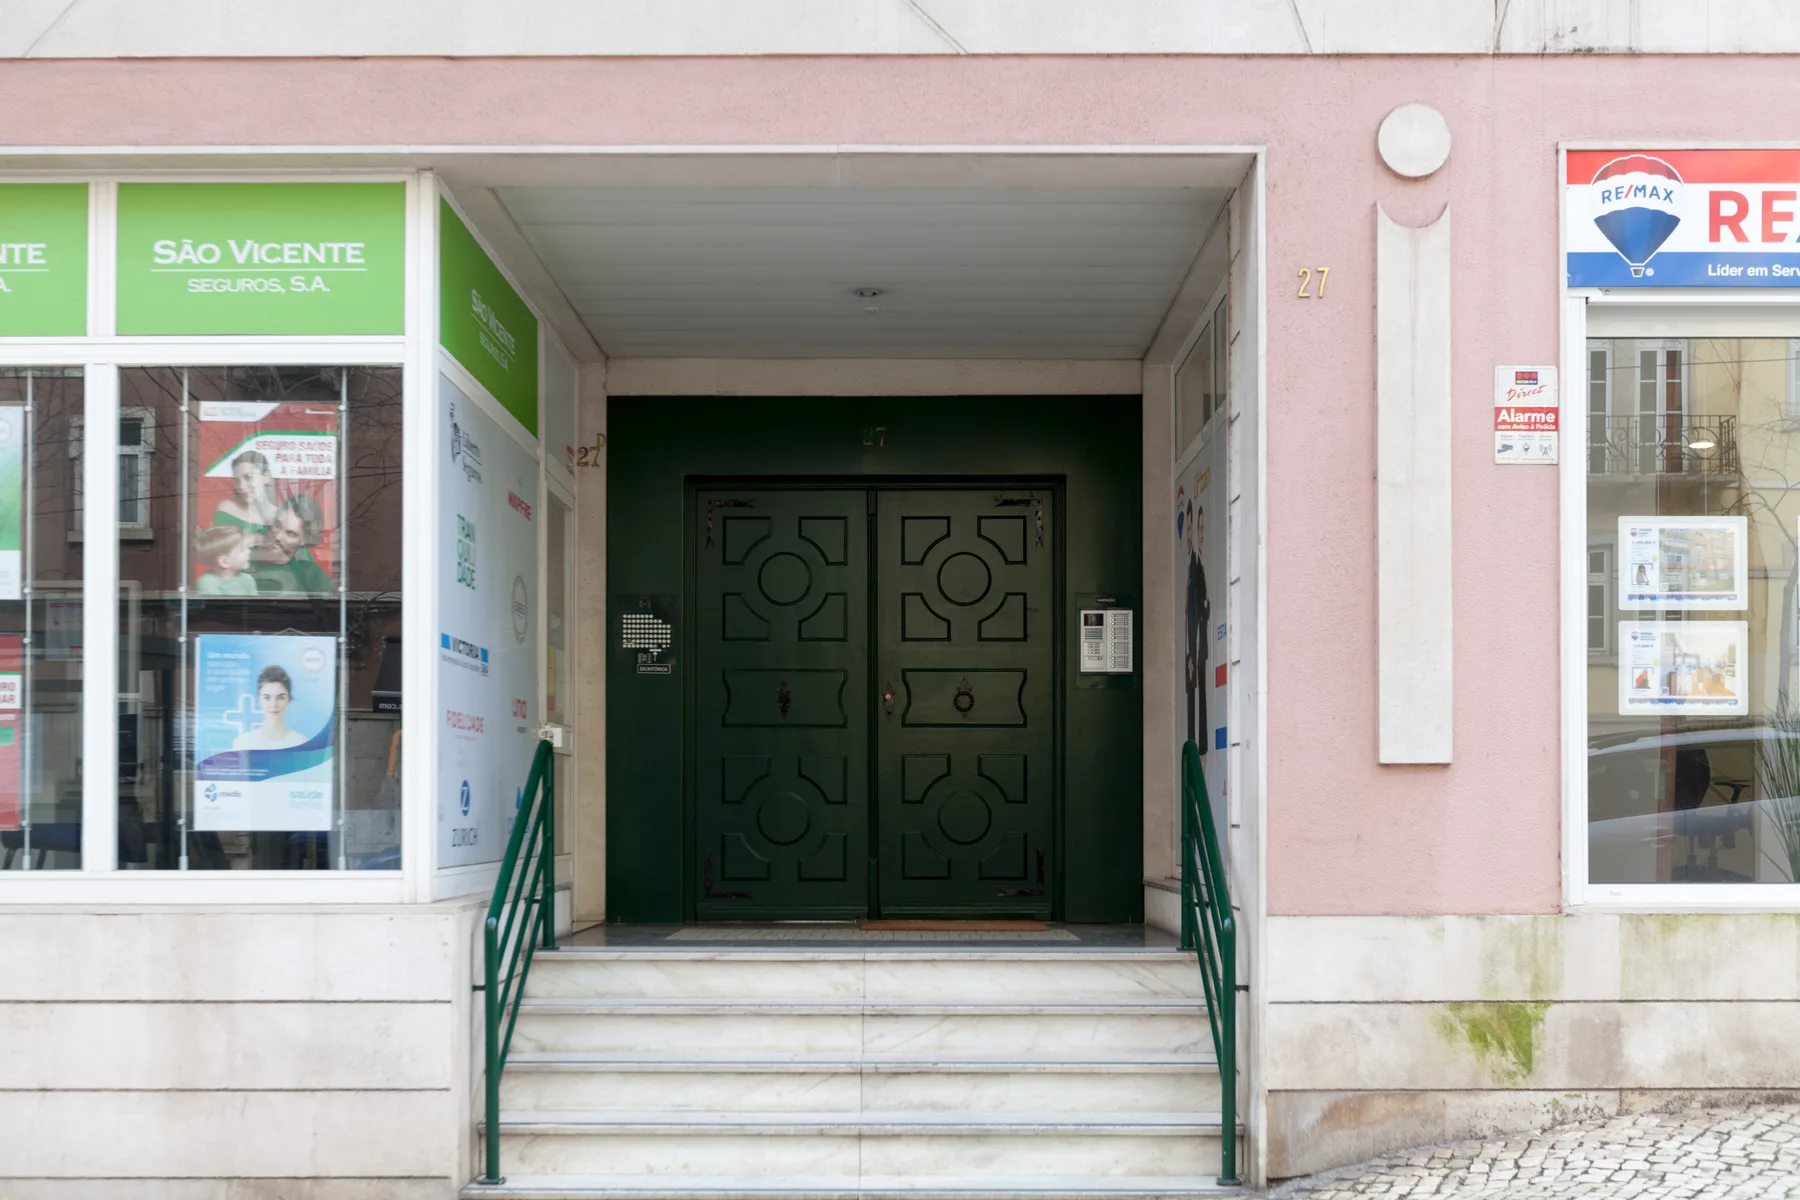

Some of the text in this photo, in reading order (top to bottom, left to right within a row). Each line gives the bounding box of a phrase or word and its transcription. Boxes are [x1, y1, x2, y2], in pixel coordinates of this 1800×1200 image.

[1601, 184, 1674, 204] RE/MAX
[1708, 190, 1800, 243] RE
[152, 238, 366, 265] SÃO VICENTE
[1708, 264, 1744, 276] Líder
[1747, 267, 1768, 276] em
[187, 276, 332, 294] SEGUROS, S.A.
[1298, 266, 1330, 299] 27
[1497, 409, 1556, 423] Alarme
[255, 440, 296, 450] SEGURO
[862, 426, 887, 446] 27
[275, 453, 332, 463] PARA TODA
[577, 446, 601, 467] 27
[280, 466, 287, 475] A
[452, 637, 480, 660] VICTORIA
[452, 827, 479, 848] ZURICH
